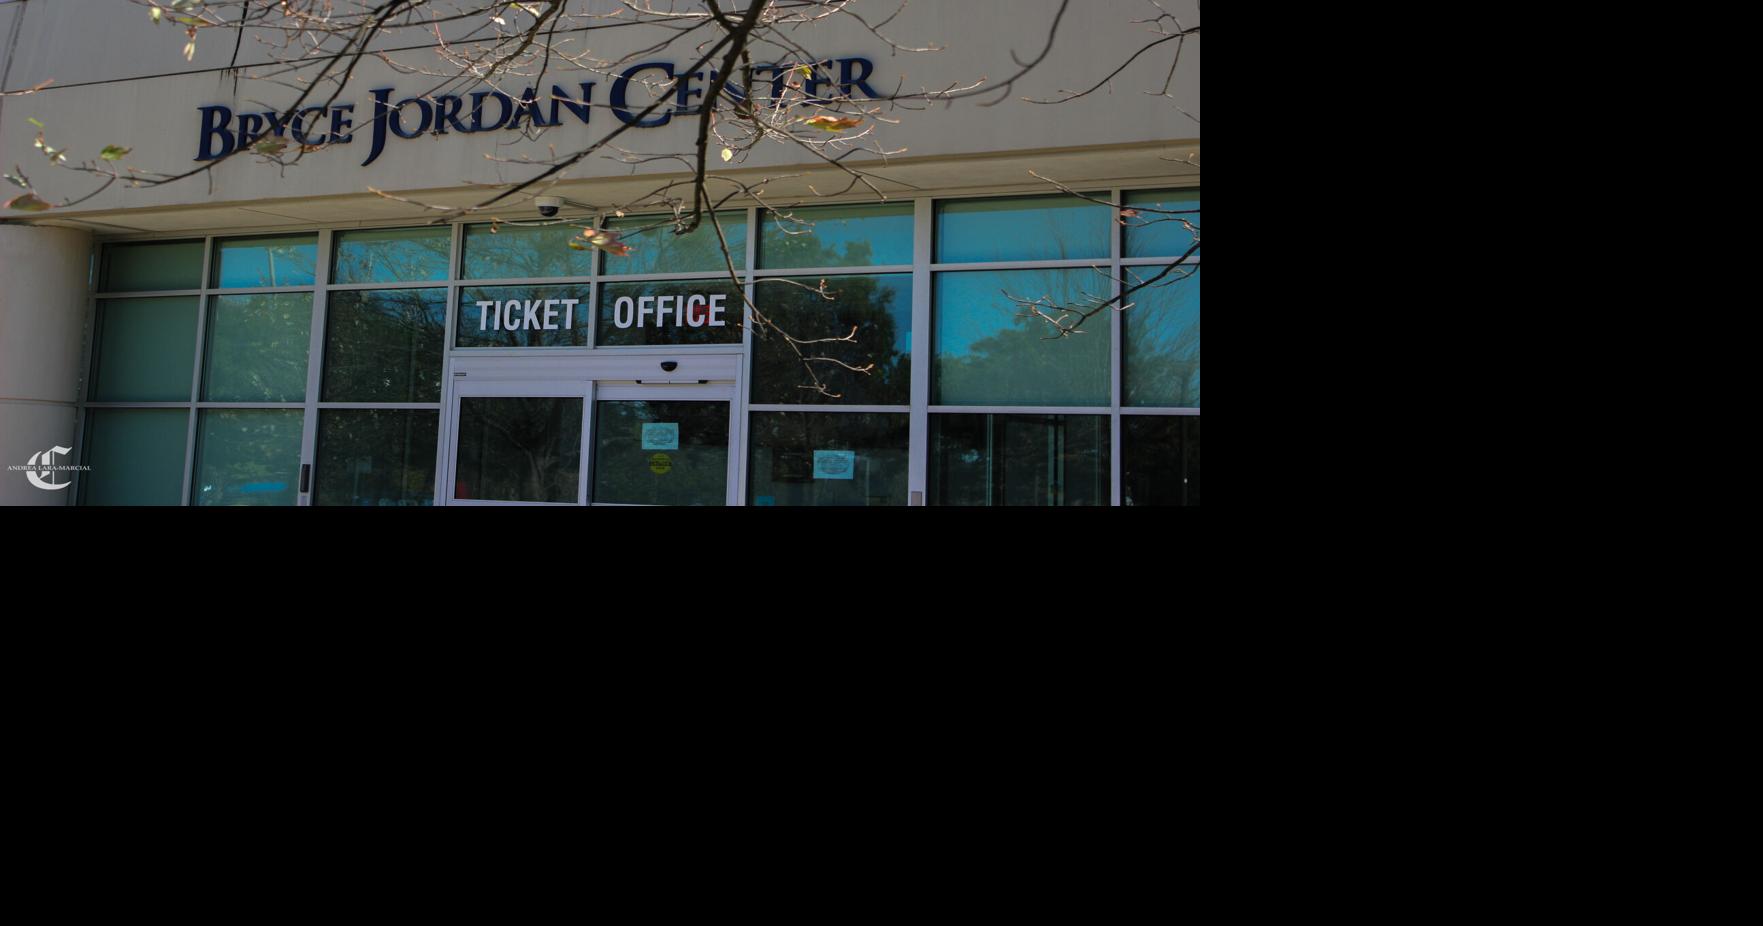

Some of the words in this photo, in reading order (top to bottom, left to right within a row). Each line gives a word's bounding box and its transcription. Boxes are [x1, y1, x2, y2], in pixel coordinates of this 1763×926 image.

[193, 104, 355, 162] BRYCE
[361, 84, 596, 167] JORDAN
[476, 299, 579, 331] TICKET
[614, 294, 726, 329] OFFICE
